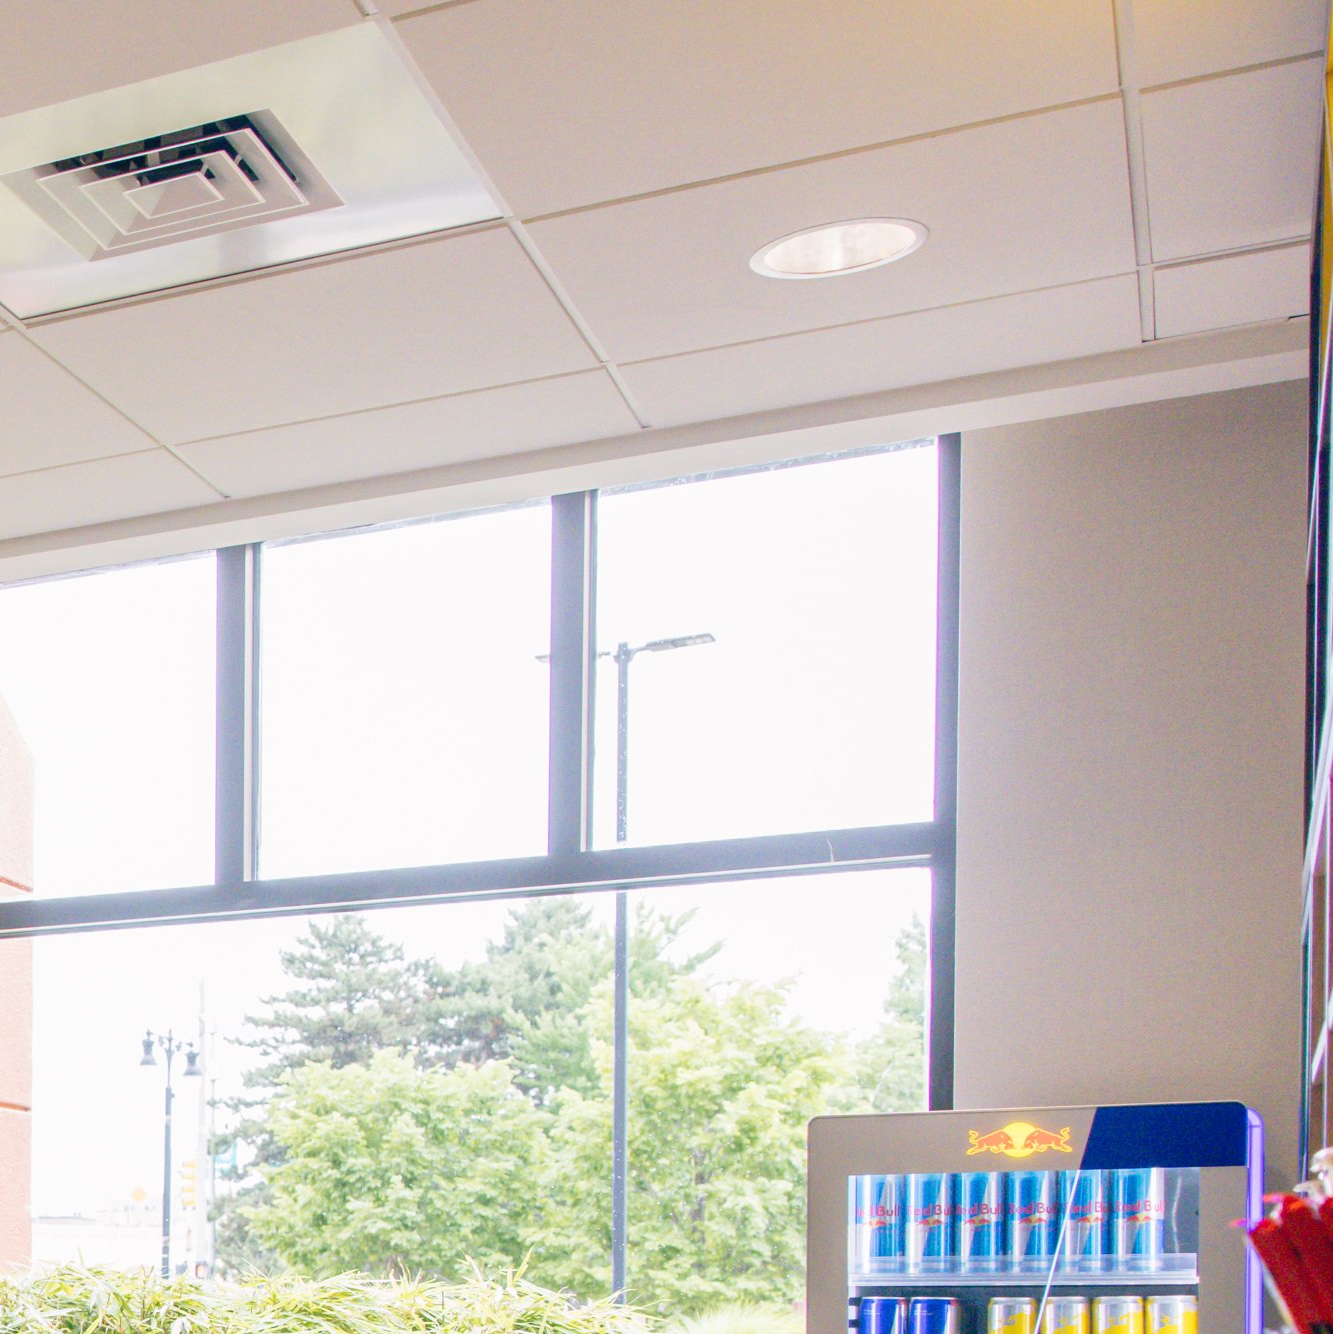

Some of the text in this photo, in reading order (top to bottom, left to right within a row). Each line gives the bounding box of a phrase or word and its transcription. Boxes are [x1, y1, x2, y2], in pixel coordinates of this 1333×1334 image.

[876, 1205, 900, 1217] Bull
[934, 1204, 954, 1216] Bu
[1114, 1200, 1141, 1213] Red
